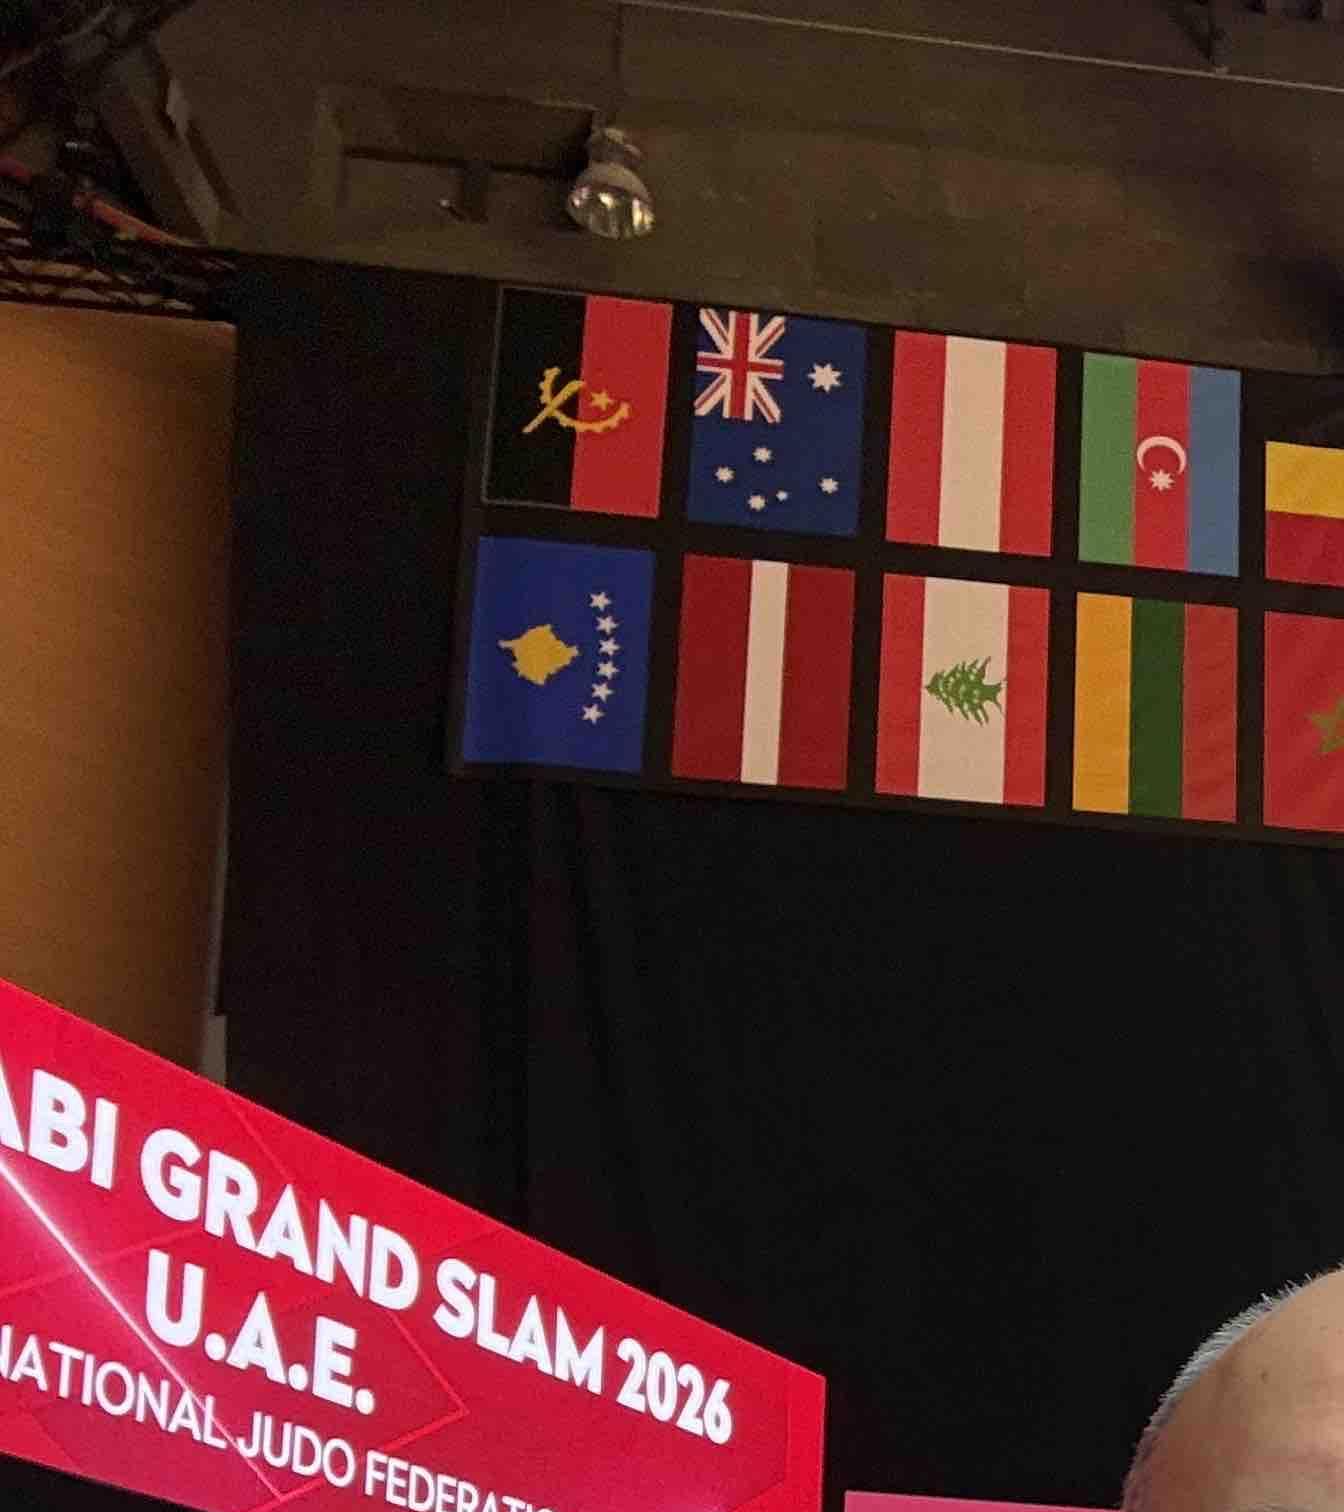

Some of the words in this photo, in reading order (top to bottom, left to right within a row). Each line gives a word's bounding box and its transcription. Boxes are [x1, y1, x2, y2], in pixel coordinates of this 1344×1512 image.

[140, 1128, 419, 1310] GRAND
[432, 1258, 604, 1395] SLAM
[616, 1337, 732, 1444] 2026
[146, 1249, 375, 1415] U.A.E.
[238, 1411, 355, 1488] JUDO
